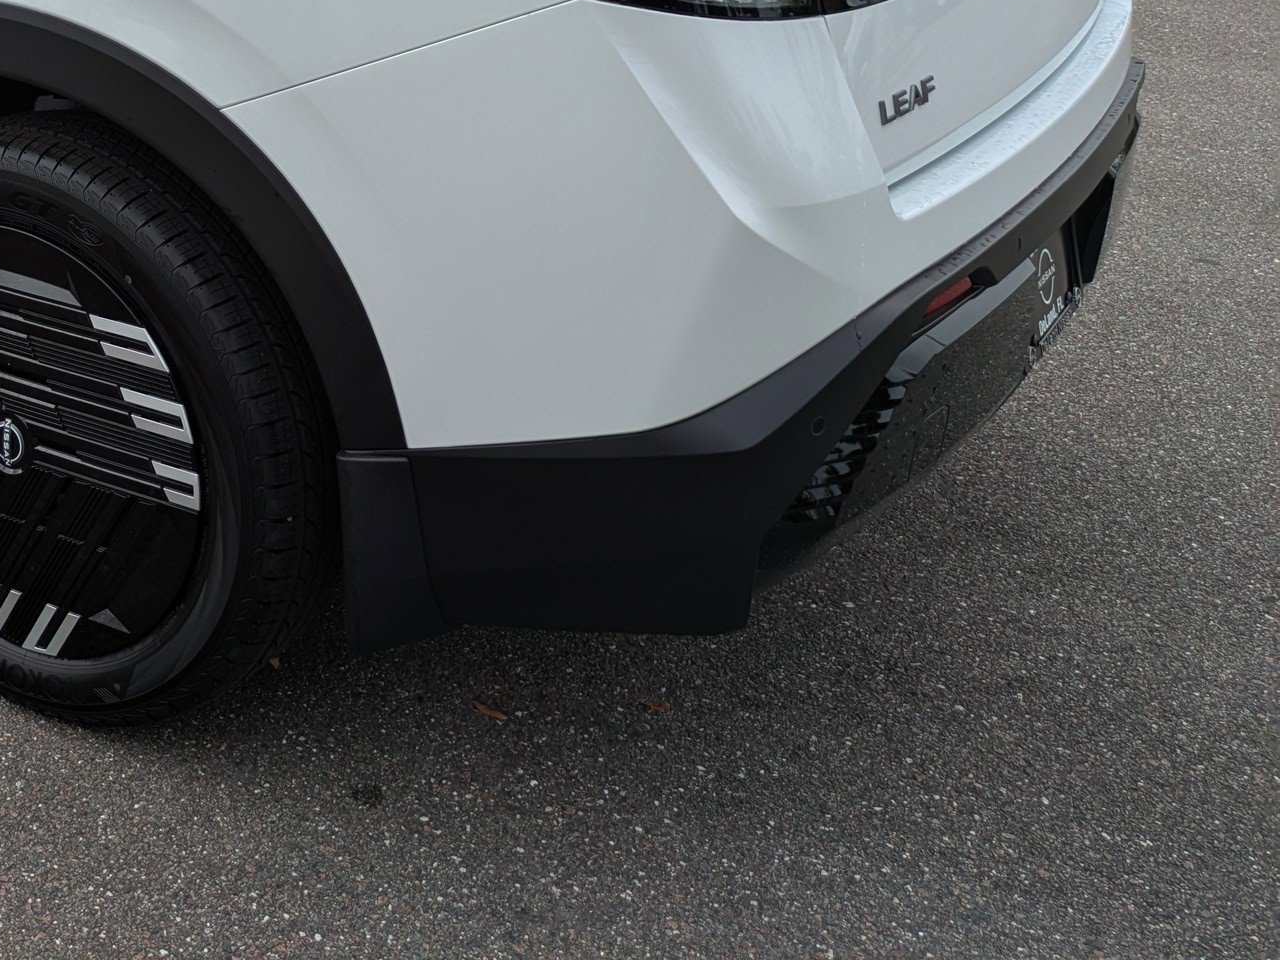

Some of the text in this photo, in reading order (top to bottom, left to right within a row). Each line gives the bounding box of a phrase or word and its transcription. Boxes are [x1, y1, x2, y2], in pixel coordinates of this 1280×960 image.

[878, 74, 936, 126] LEAF
[1037, 263, 1056, 290] NISSAN
[3, 417, 13, 467] NISSAN
